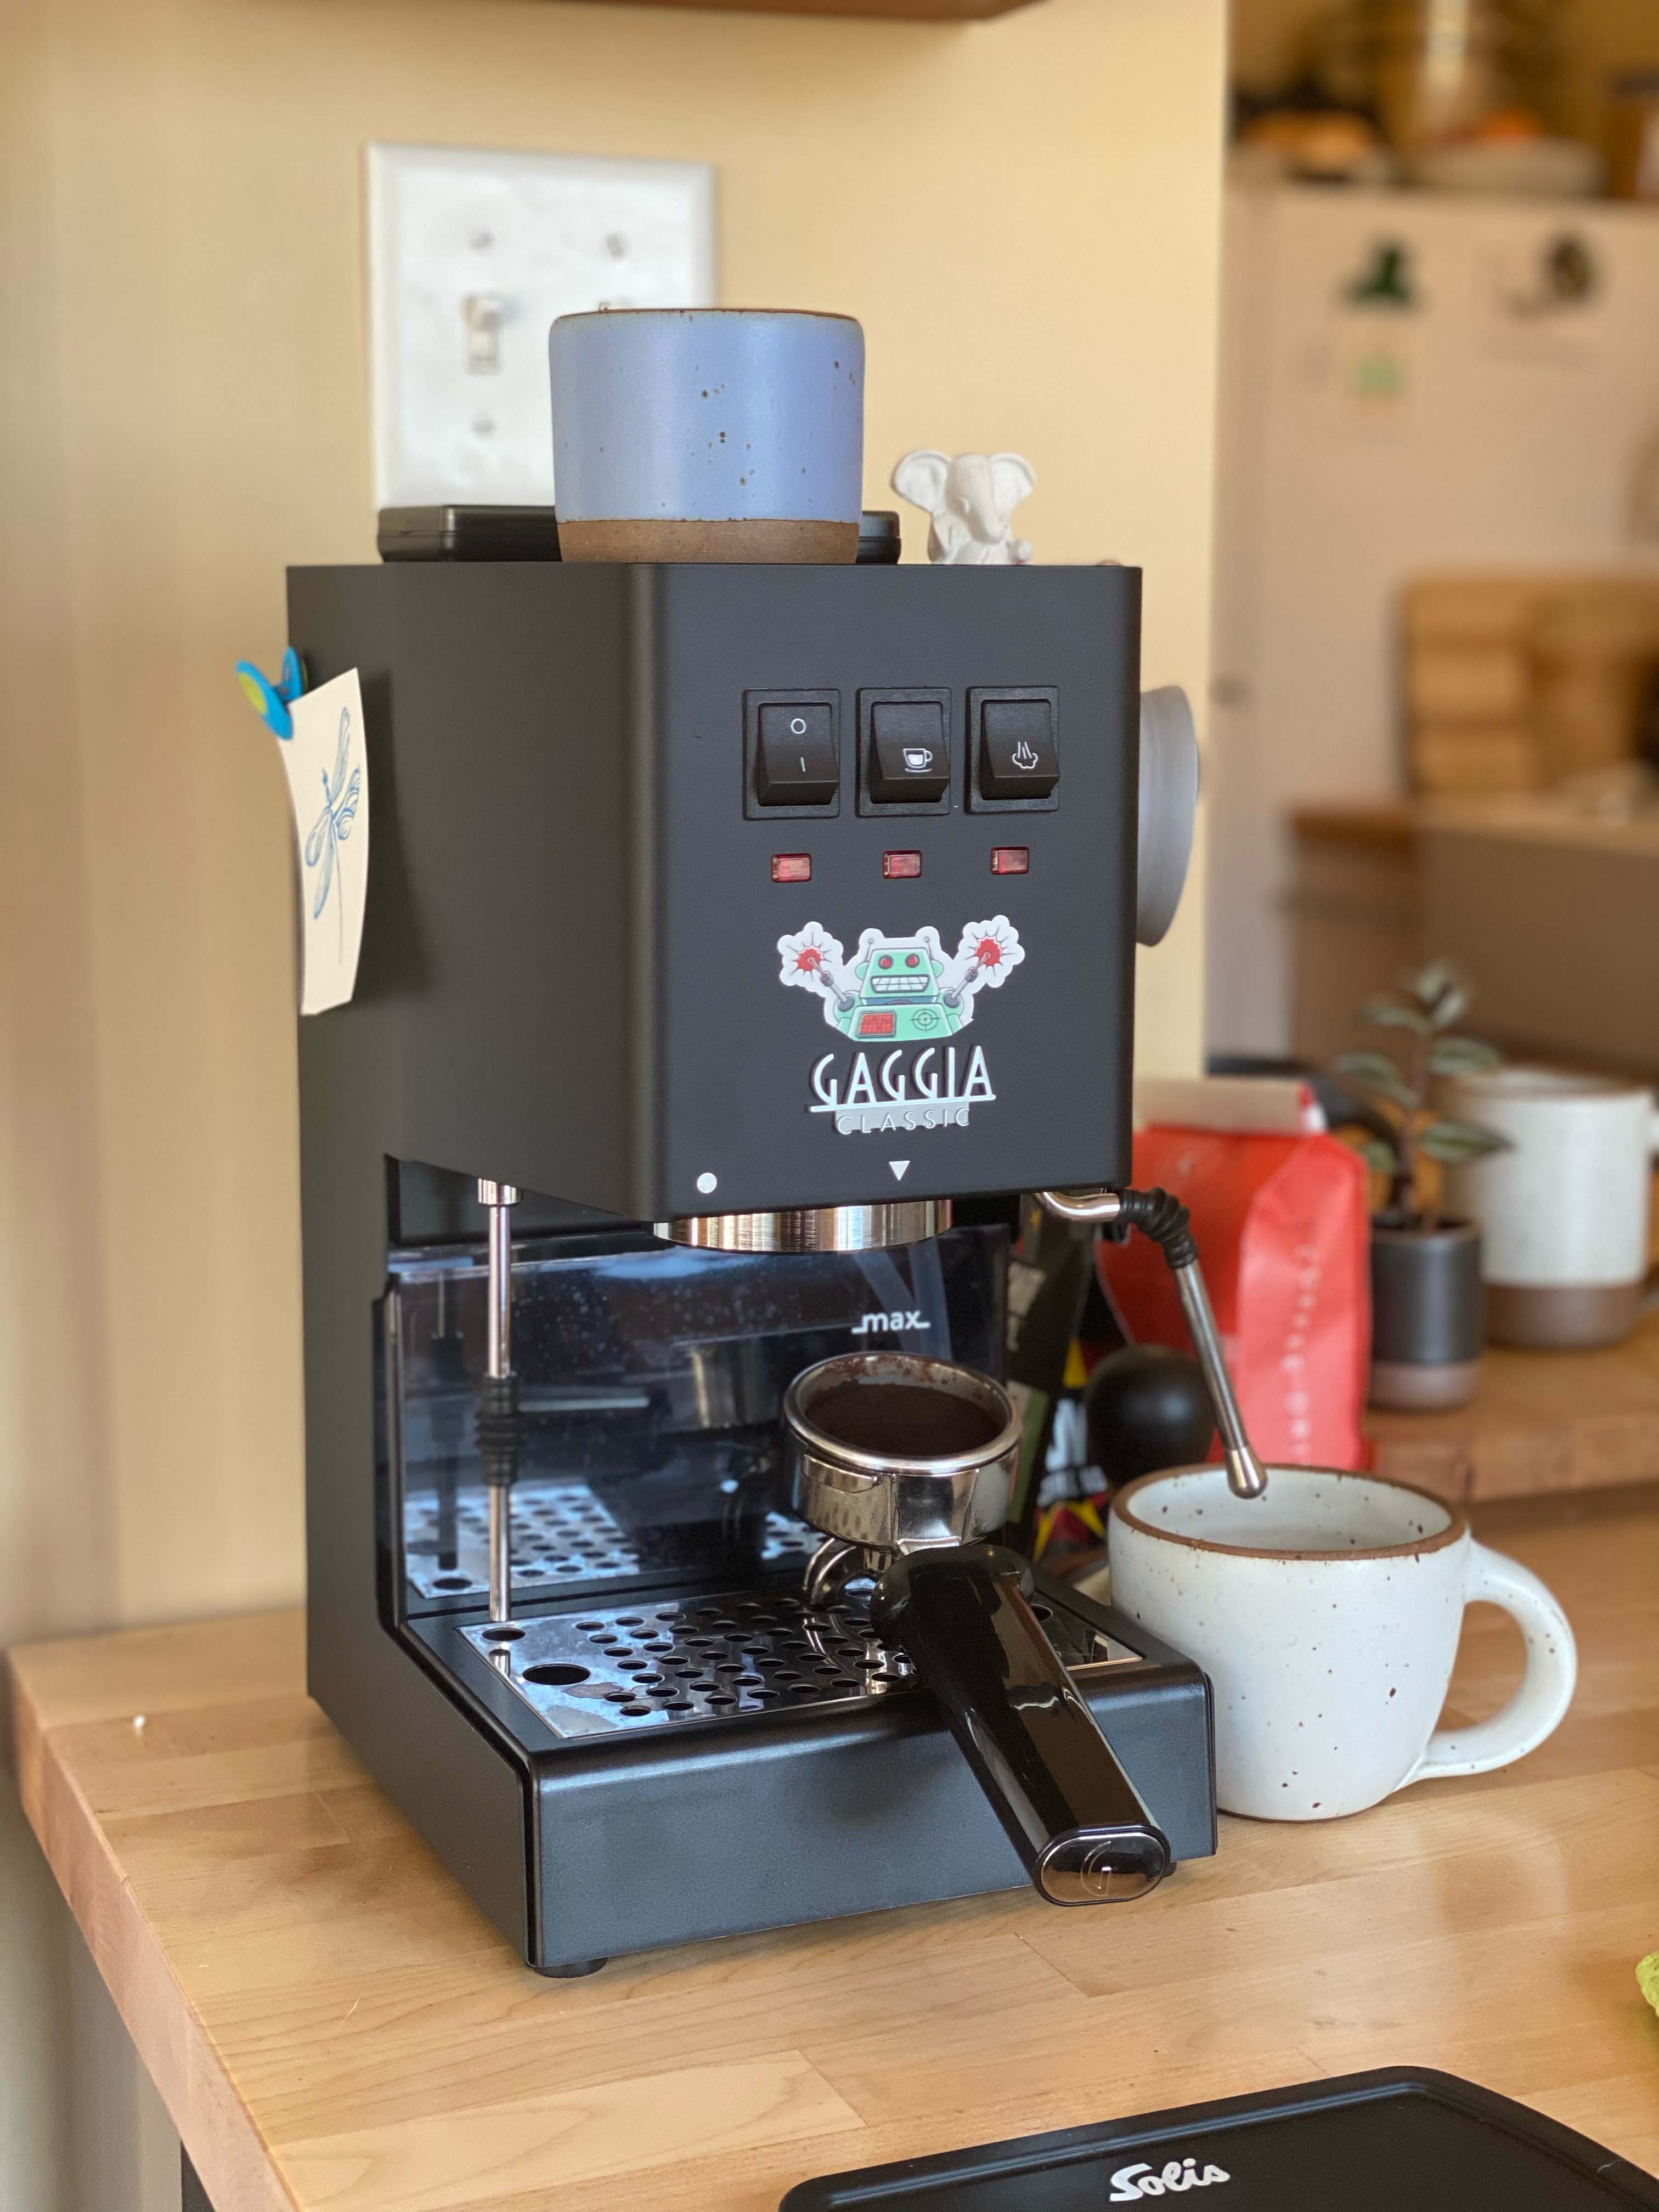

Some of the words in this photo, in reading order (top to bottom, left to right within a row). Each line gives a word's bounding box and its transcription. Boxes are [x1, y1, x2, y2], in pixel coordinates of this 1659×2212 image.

[811, 1045, 995, 1109] GAGGIA
[837, 1107, 970, 1135] CLASSIC
[1109, 2157, 1231, 2202] Solis
